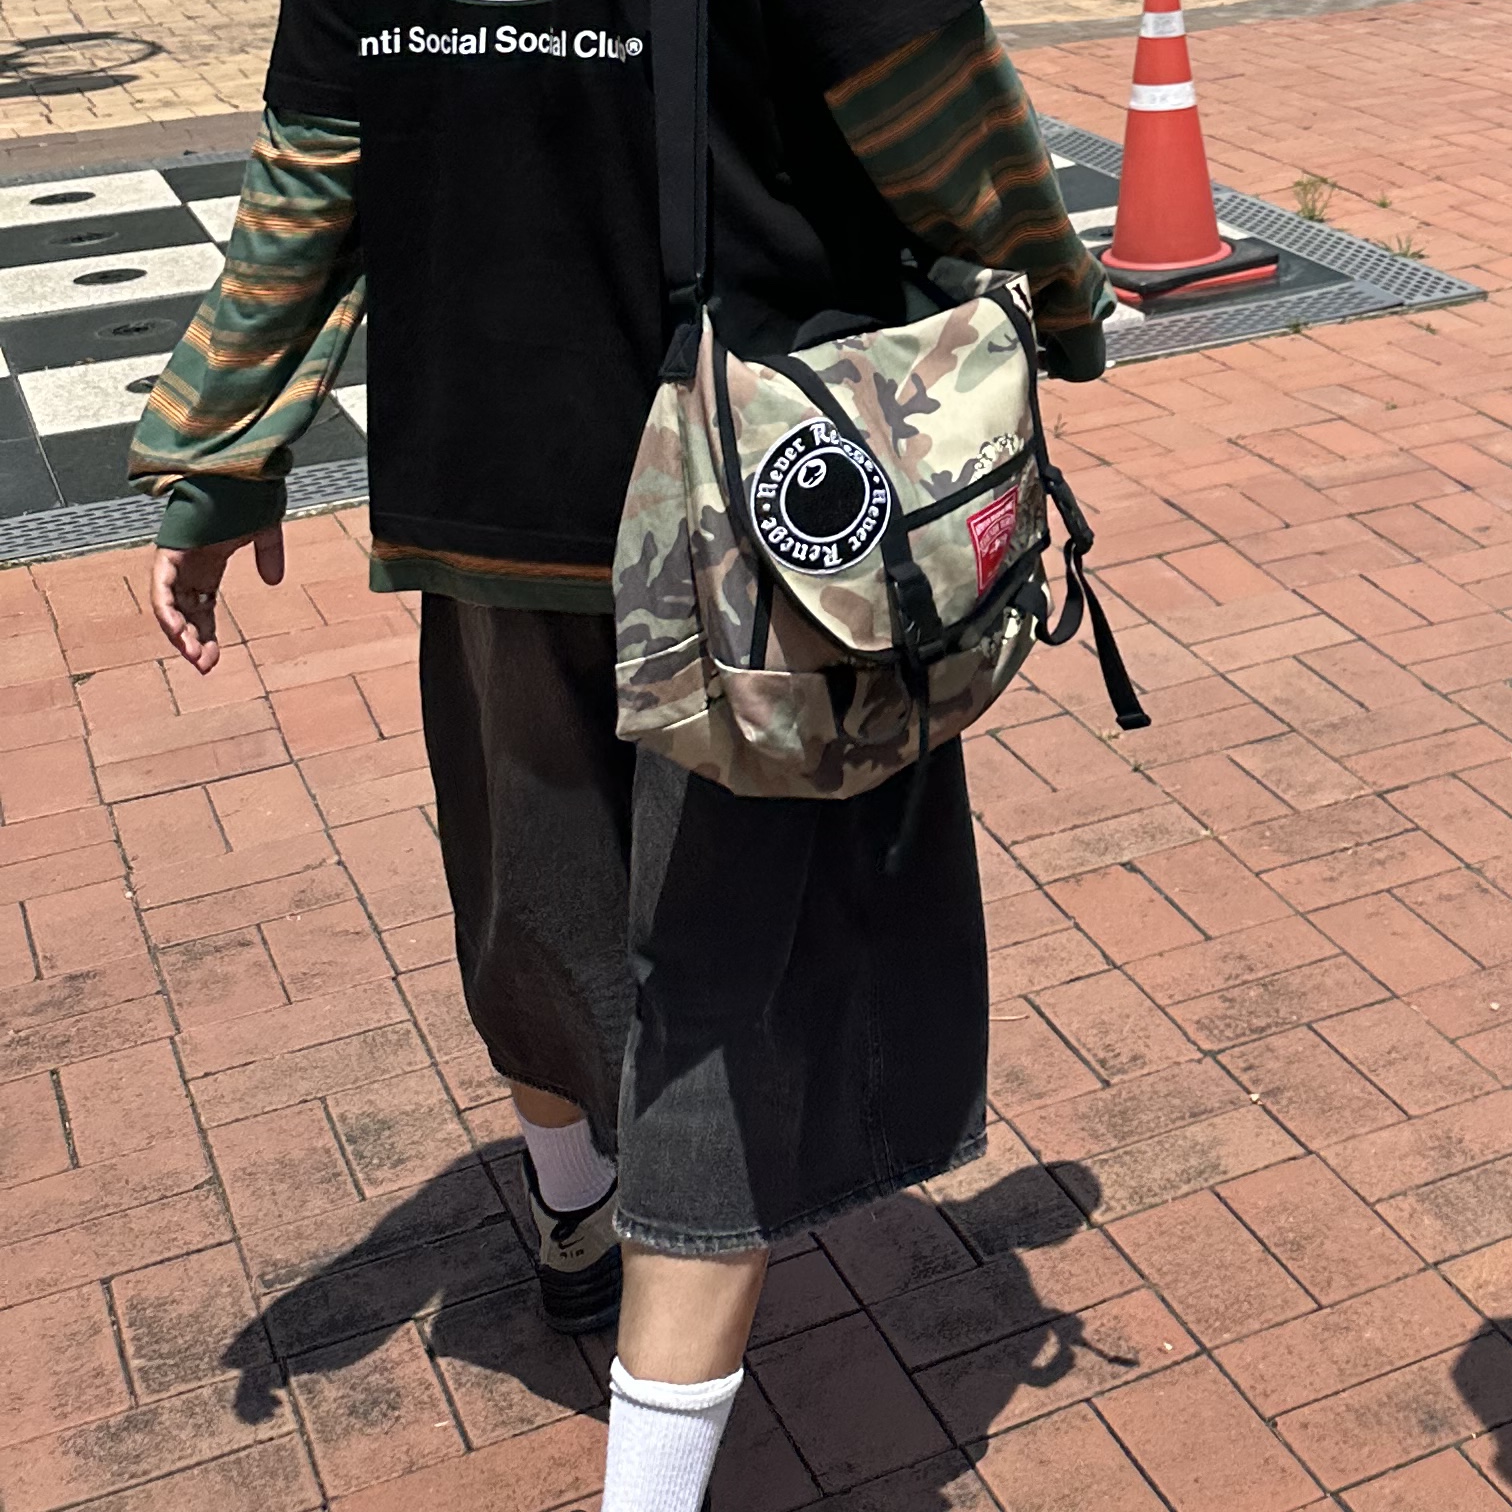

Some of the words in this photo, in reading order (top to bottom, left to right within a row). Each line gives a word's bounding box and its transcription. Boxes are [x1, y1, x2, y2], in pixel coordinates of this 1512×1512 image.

[358, 26, 401, 56] nti
[408, 25, 487, 55] Social
[495, 24, 567, 57] Social
